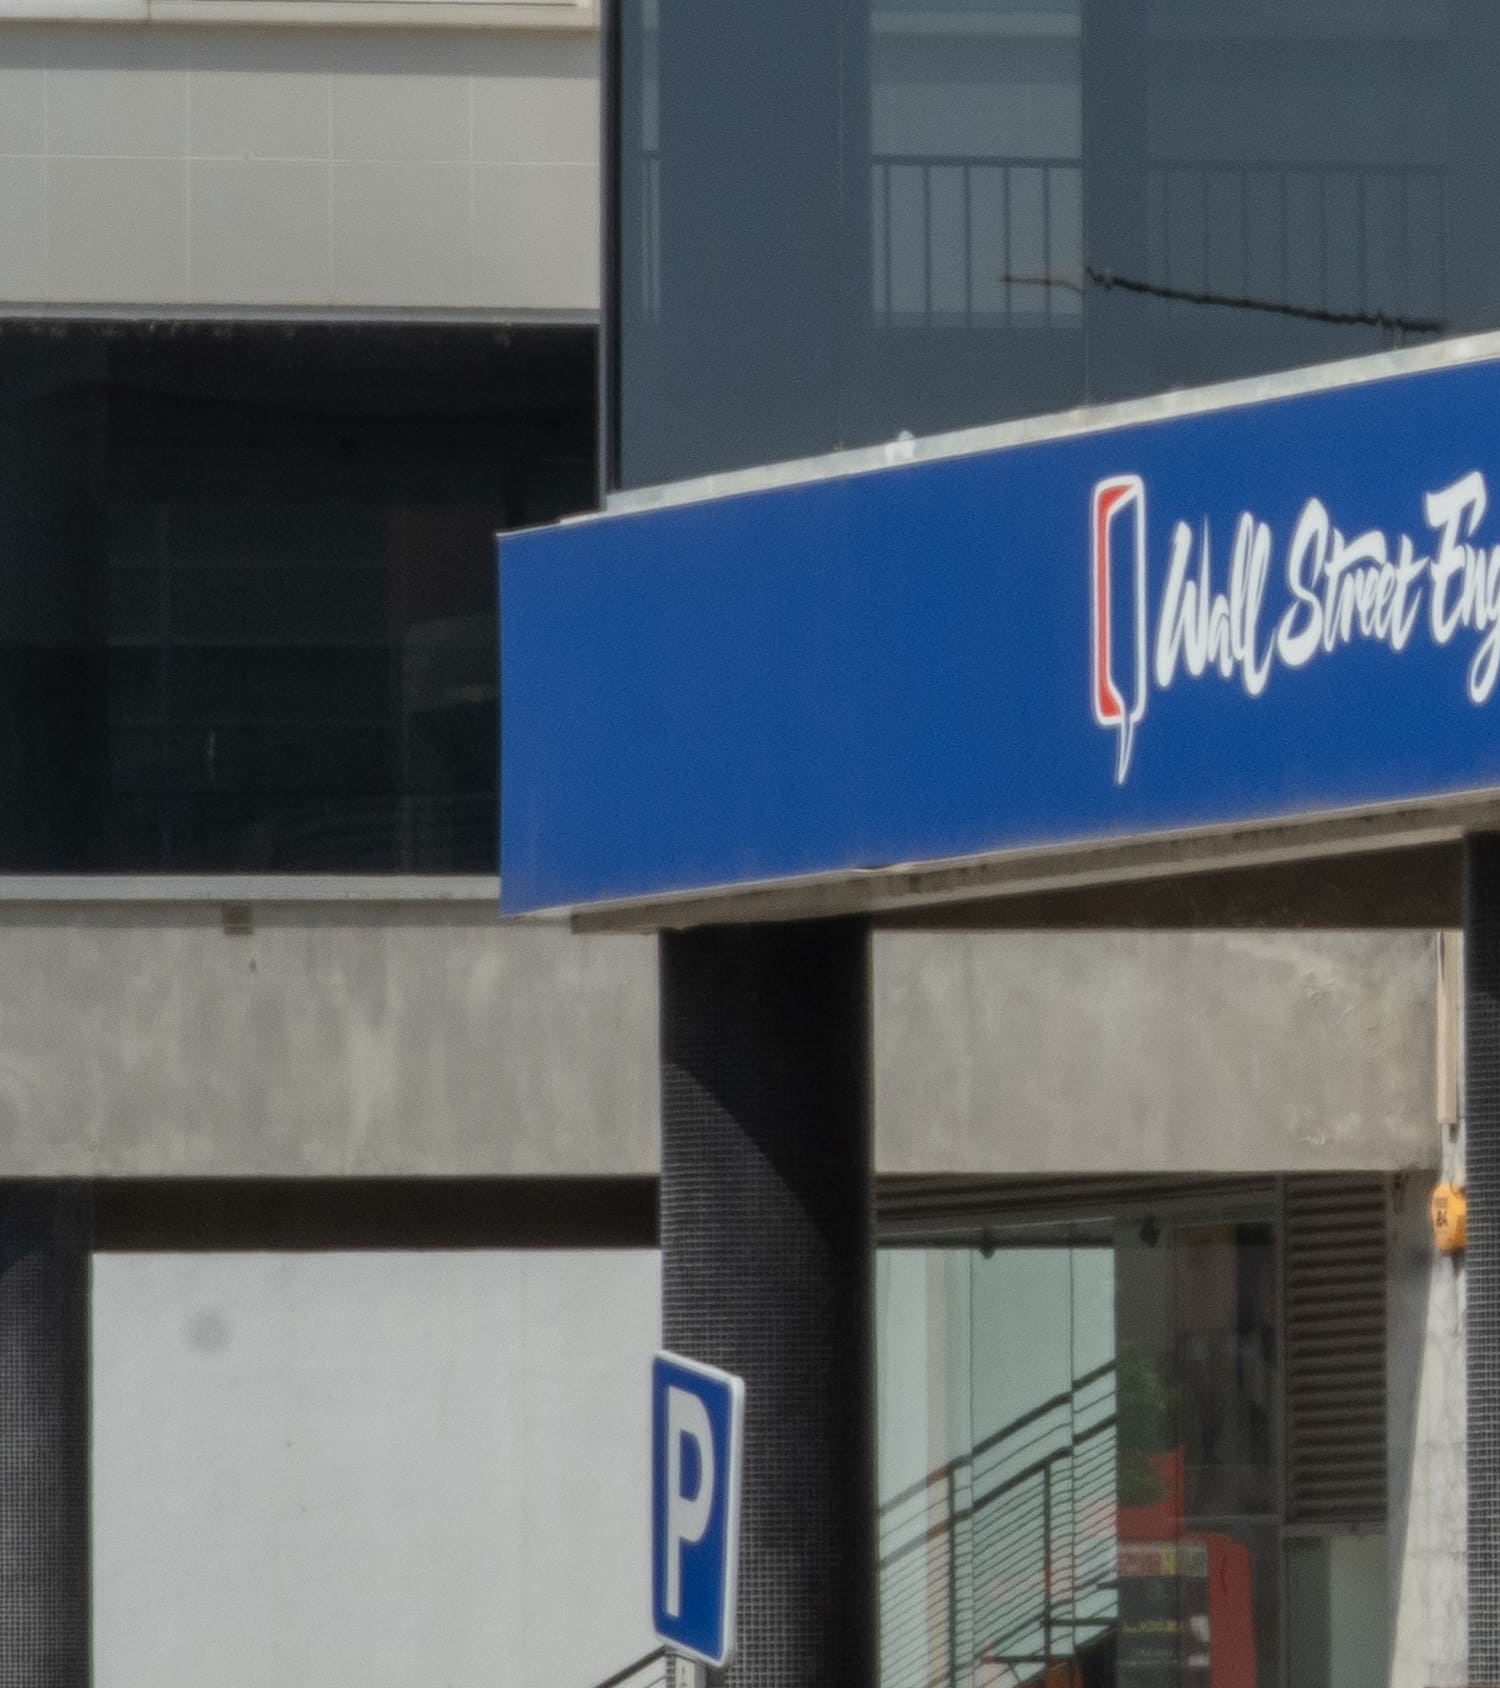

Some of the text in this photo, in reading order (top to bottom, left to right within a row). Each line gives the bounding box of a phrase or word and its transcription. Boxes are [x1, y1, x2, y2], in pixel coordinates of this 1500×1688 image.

[1155, 511, 1276, 696] Wall
[1277, 497, 1429, 667] Street
[664, 1386, 714, 1618] P
